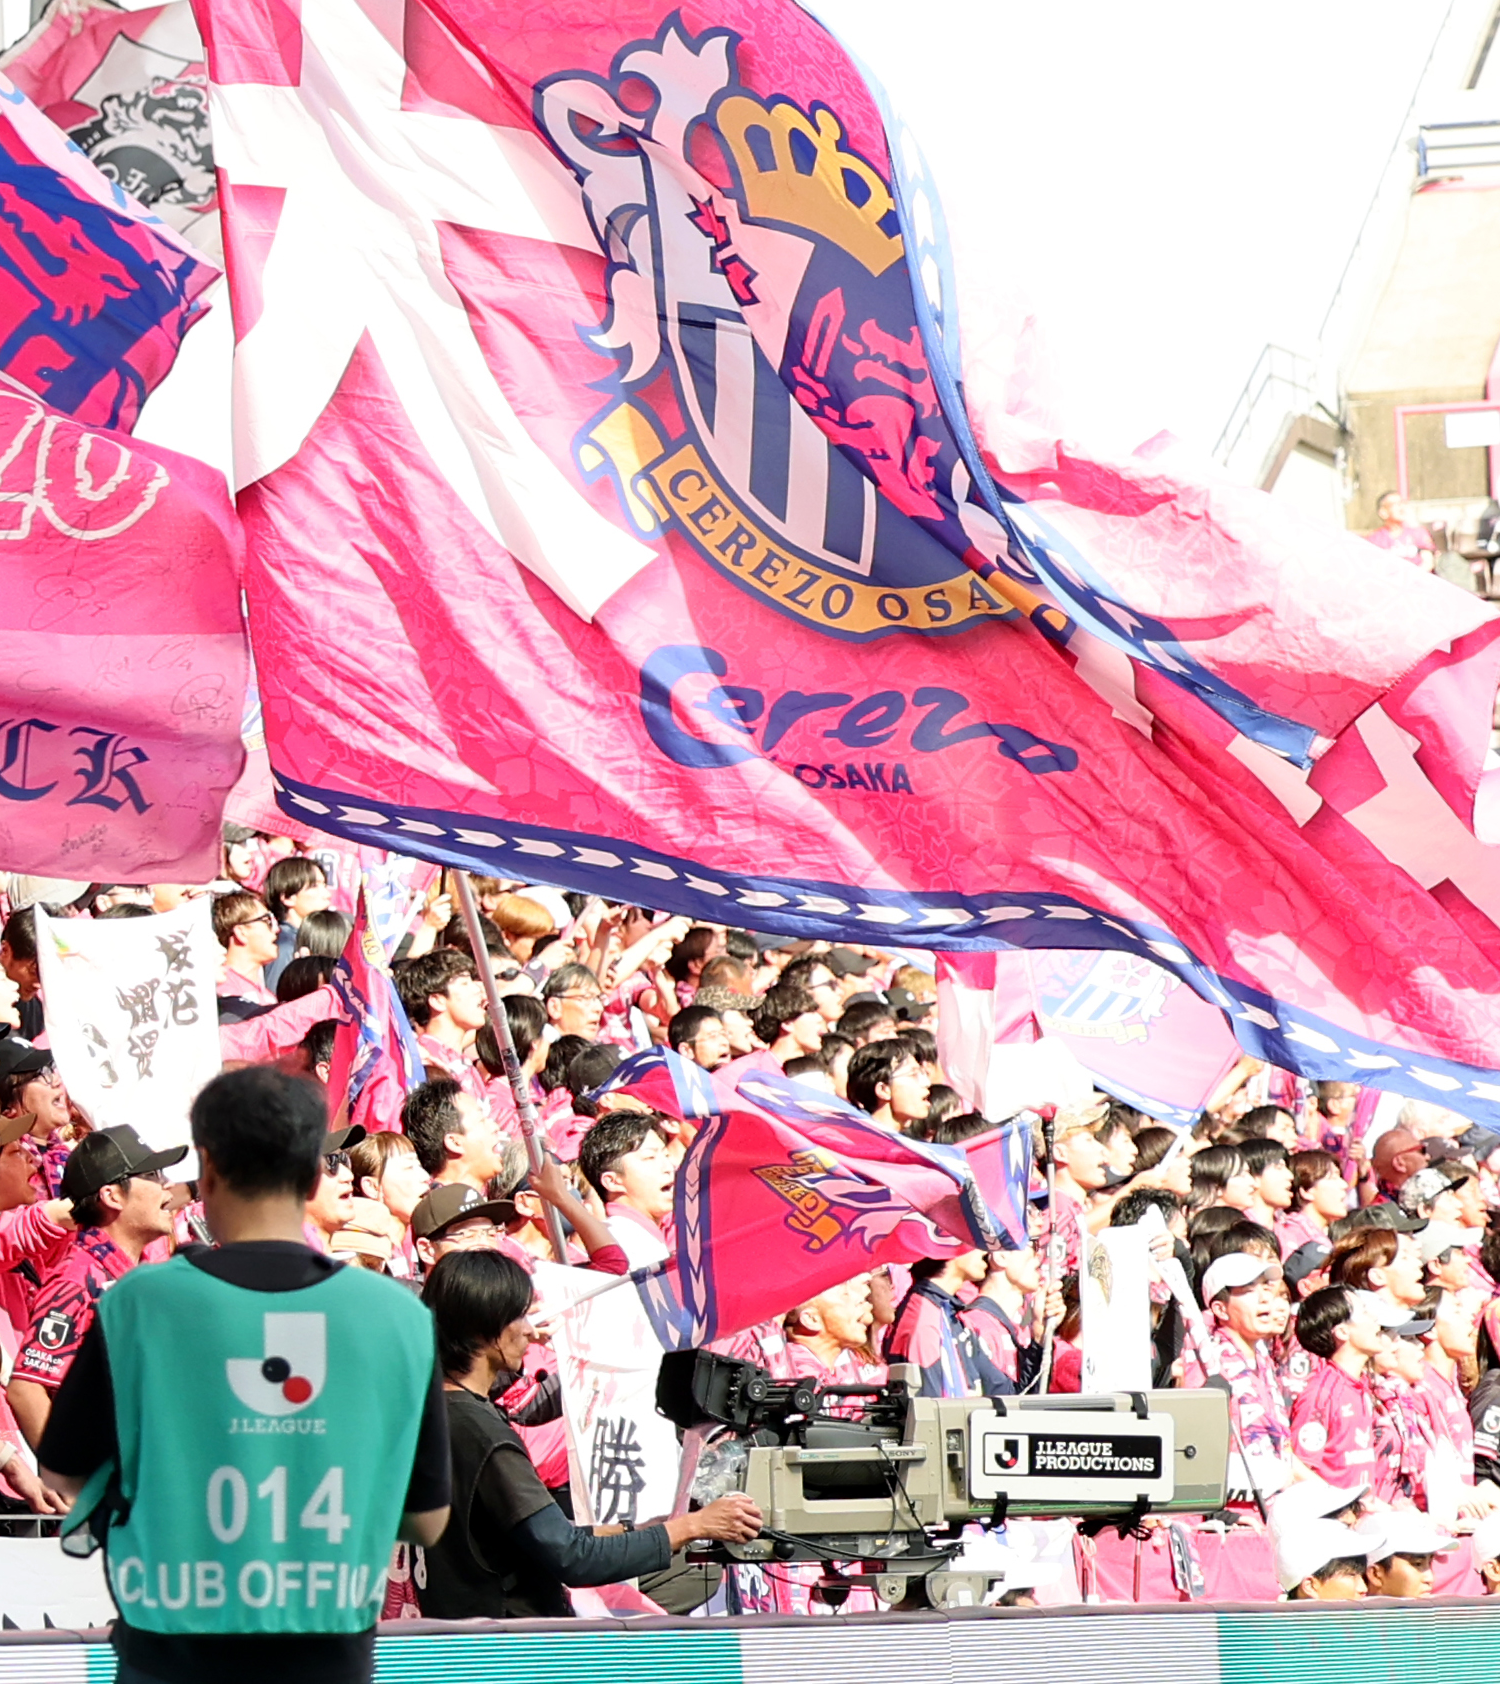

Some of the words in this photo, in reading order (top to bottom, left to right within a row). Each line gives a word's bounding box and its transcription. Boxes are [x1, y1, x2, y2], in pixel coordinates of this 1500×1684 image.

[666, 466, 856, 622] CEREZO
[876, 569, 1011, 624] OSA
[638, 641, 1082, 776] Cerezo
[795, 760, 913, 796] OSAKA
[228, 1418, 327, 1435] J.LEAGUE
[888, 1450, 917, 1458] SONY
[1035, 1441, 1113, 1456] J.LEAGUE
[1035, 1455, 1155, 1472] PRODUCTIONS
[206, 1465, 350, 1545] 014
[116, 1556, 226, 1609] CLUB
